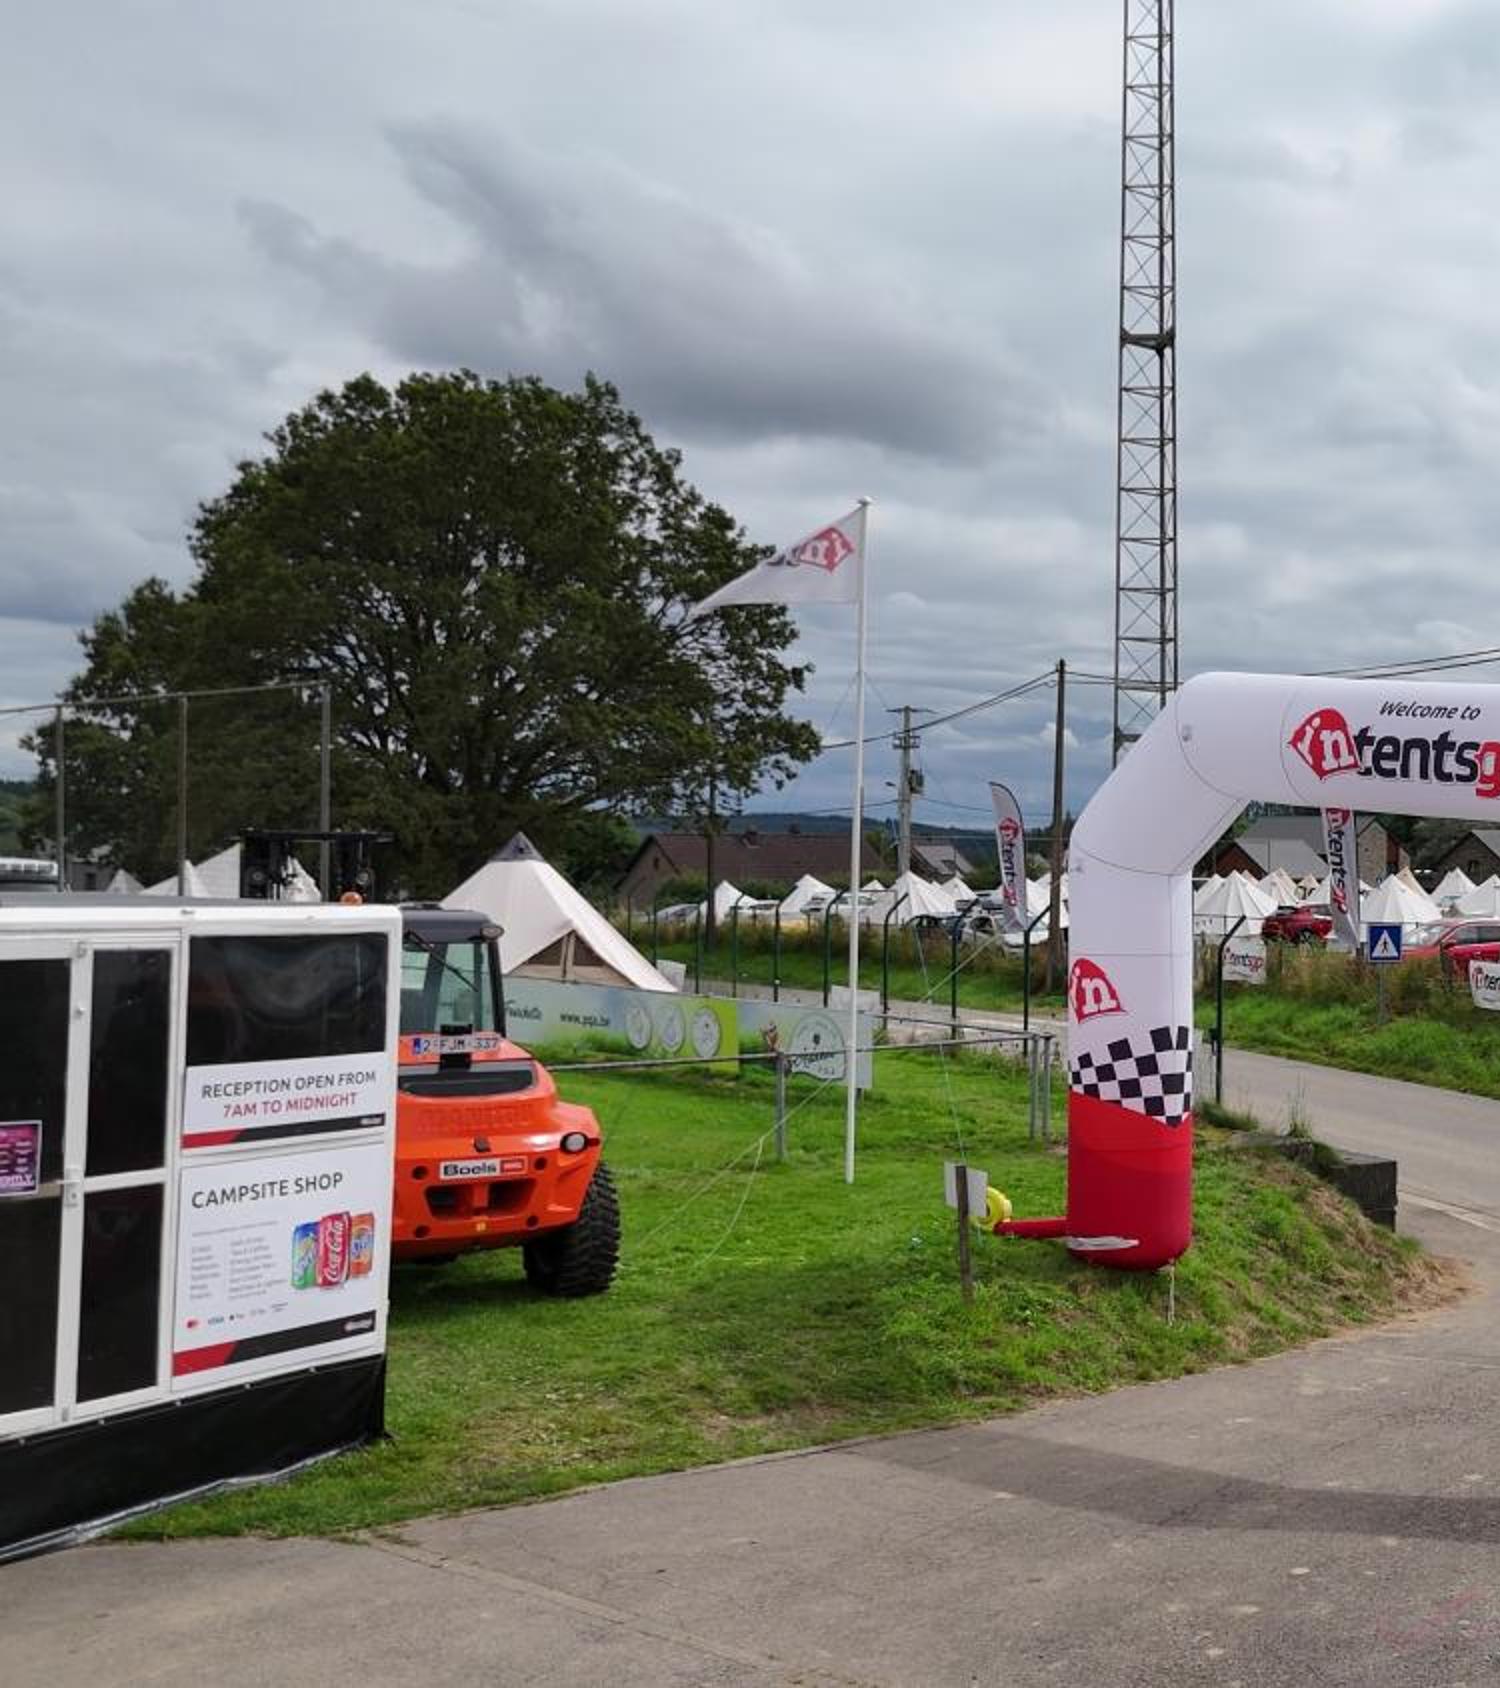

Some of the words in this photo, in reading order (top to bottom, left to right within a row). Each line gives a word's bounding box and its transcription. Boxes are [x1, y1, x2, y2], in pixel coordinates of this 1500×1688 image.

[1379, 701, 1459, 719] Welcome
[1460, 704, 1481, 721] to
[202, 1079, 291, 1099] RECEPTION
[295, 1073, 335, 1091] OPEN
[337, 1070, 377, 1086] FROM
[223, 1103, 257, 1118] 7AM
[262, 1100, 282, 1115] TO
[286, 1092, 357, 1112] MIDNIGHT
[443, 1162, 497, 1177] Boels
[191, 1179, 289, 1209] CAMPSITE
[294, 1171, 343, 1195] SHOP
